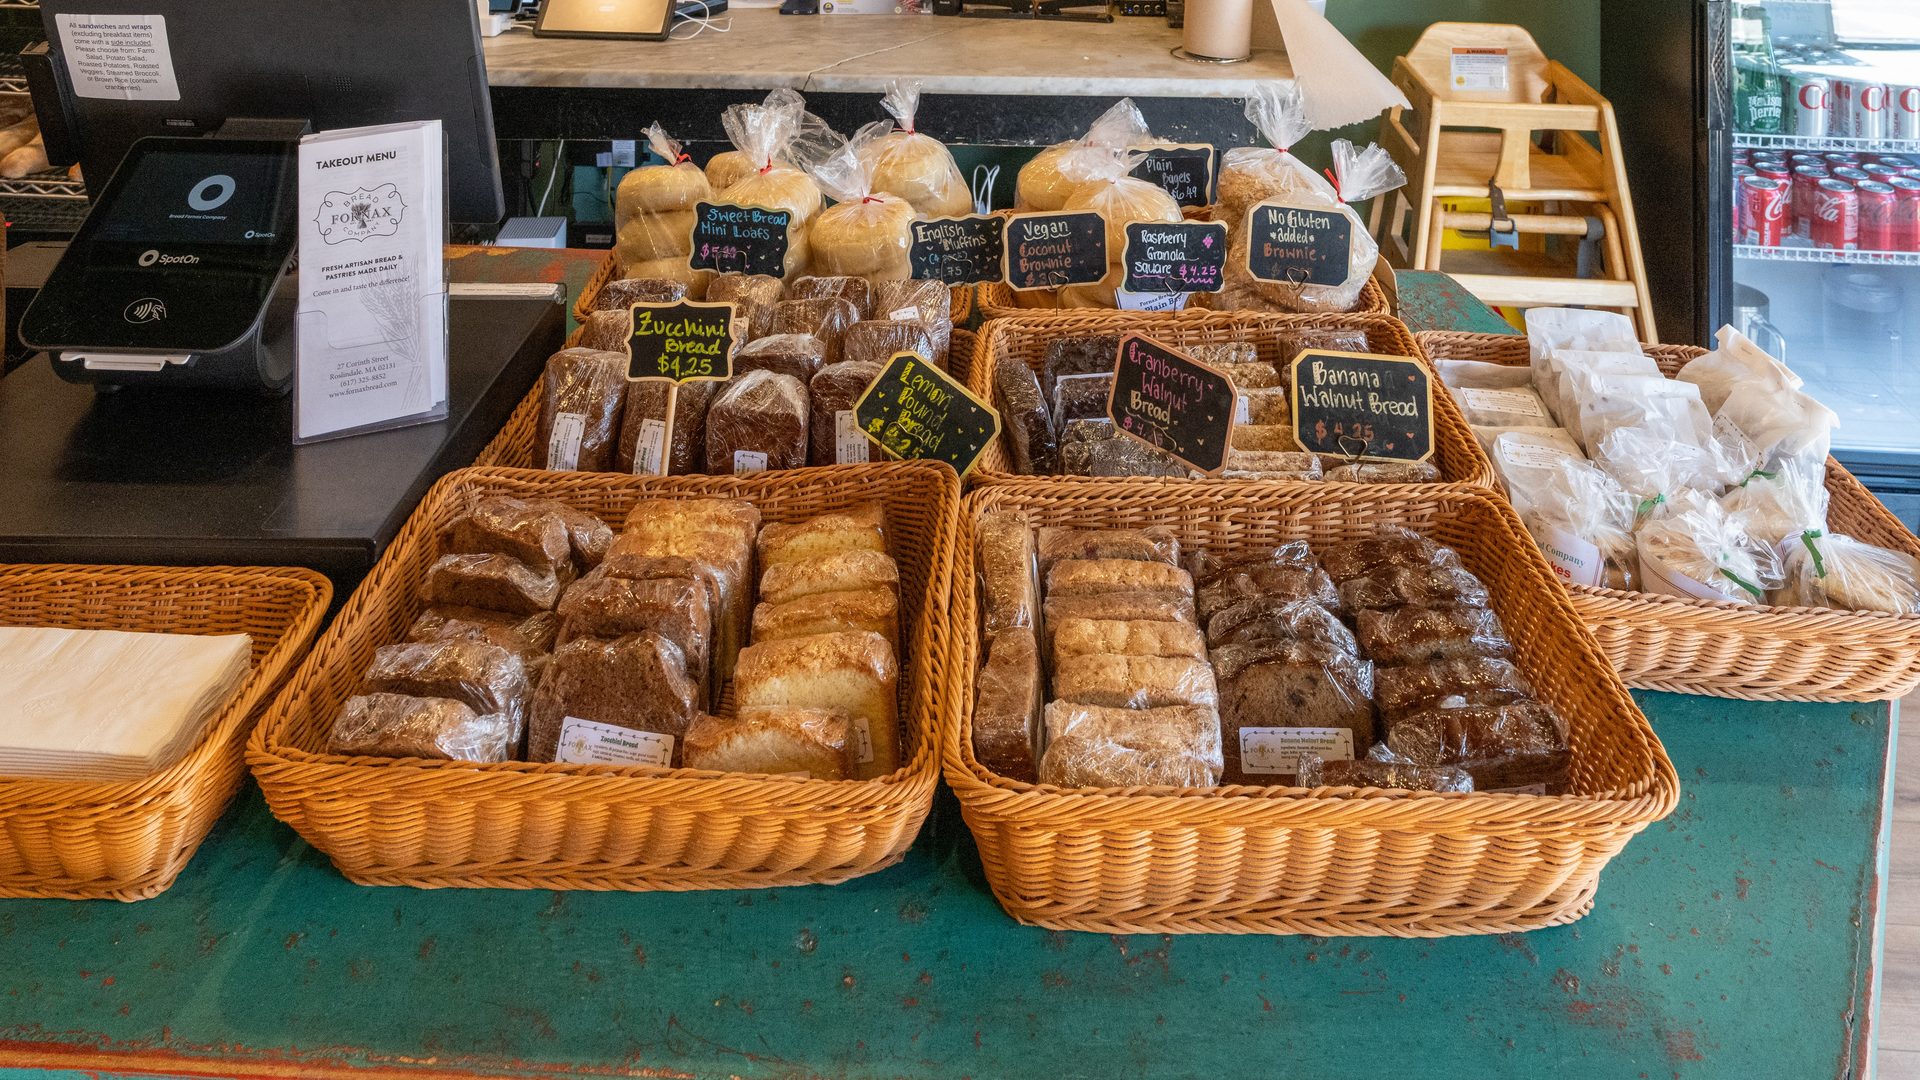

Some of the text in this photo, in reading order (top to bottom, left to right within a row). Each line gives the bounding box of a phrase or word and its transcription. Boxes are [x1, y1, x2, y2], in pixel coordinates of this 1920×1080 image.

[72, 30, 102, 38] (excluding
[316, 151, 397, 170] TAKEOUT MENU
[1146, 159, 1173, 173] Plain
[1162, 172, 1191, 190] Bagels
[343, 193, 379, 208] BREAD
[707, 208, 787, 226] Sweet Bread
[1268, 209, 1330, 230] No Gluten
[343, 222, 380, 237] COMPANY
[701, 221, 770, 240] Mini Loafs
[916, 224, 965, 244] English
[1023, 221, 1069, 240] Vegan
[1277, 228, 1308, 244] added
[942, 234, 987, 251] Muffins
[1020, 239, 1072, 257] Coconut
[1141, 230, 1187, 248] Raspberry
[159, 254, 200, 265] SpotOn
[1146, 246, 1185, 261] Granola
[1263, 242, 1317, 261] Brownie
[321, 264, 343, 273] FRESH
[344, 260, 373, 269] ARTISAN
[375, 255, 397, 264] BREAD
[325, 263, 398, 281] PASTRIES MADE DAILY
[1020, 256, 1072, 273] Brownie
[1179, 263, 1217, 278] $4.25
[340, 285, 352, 293] and
[634, 311, 726, 337] Zucchini
[665, 338, 721, 355] Bread
[346, 358, 370, 369] Corinth
[371, 355, 389, 363] Street
[378, 362, 396, 371] 02131
[657, 353, 713, 377] $4.25
[1129, 342, 1203, 402] Cranberry
[1312, 361, 1380, 388] Banana
[329, 381, 398, 398] www.fornaxbread.com
[340, 378, 357, 388] (617)
[900, 361, 954, 411] Lemon
[1142, 372, 1188, 413] Walnut
[1300, 385, 1418, 418] Walnut Bread
[898, 387, 947, 431] Pound
[1130, 390, 1171, 424] Bread
[898, 409, 945, 453] Bread
[1546, 544, 1584, 568] Company
[1550, 560, 1571, 578] kes
[601, 735, 638, 749] Zucchini Bread
